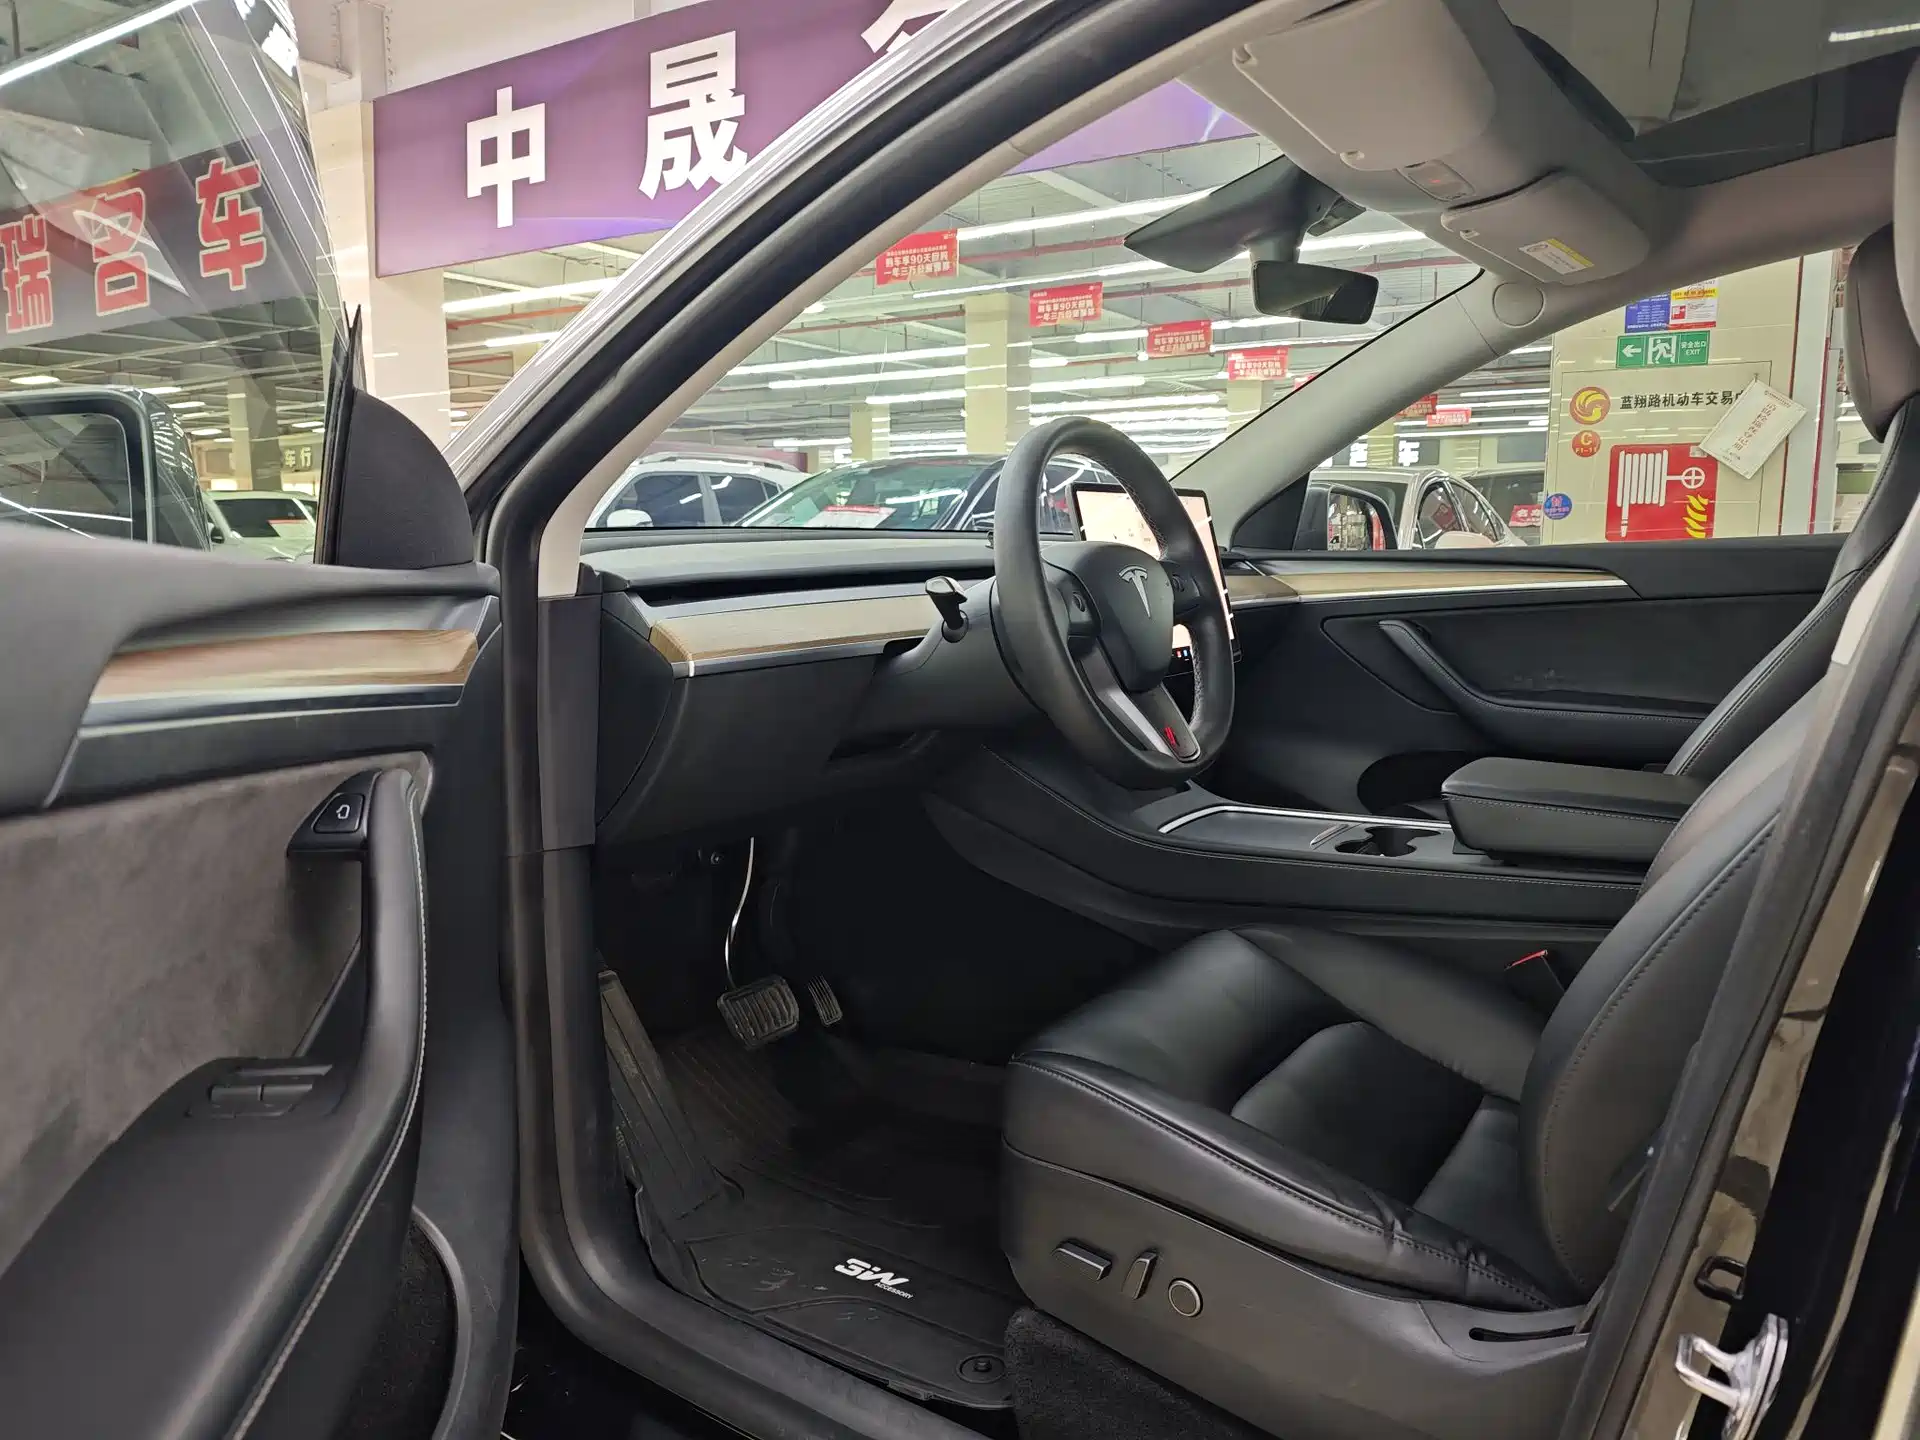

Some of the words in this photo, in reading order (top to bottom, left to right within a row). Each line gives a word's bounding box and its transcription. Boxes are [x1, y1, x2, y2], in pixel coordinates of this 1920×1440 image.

[1681, 341, 1706, 349] 安全出口
[1580, 432, 1592, 446] C
[874, 1282, 914, 1299] ACCESSORY
